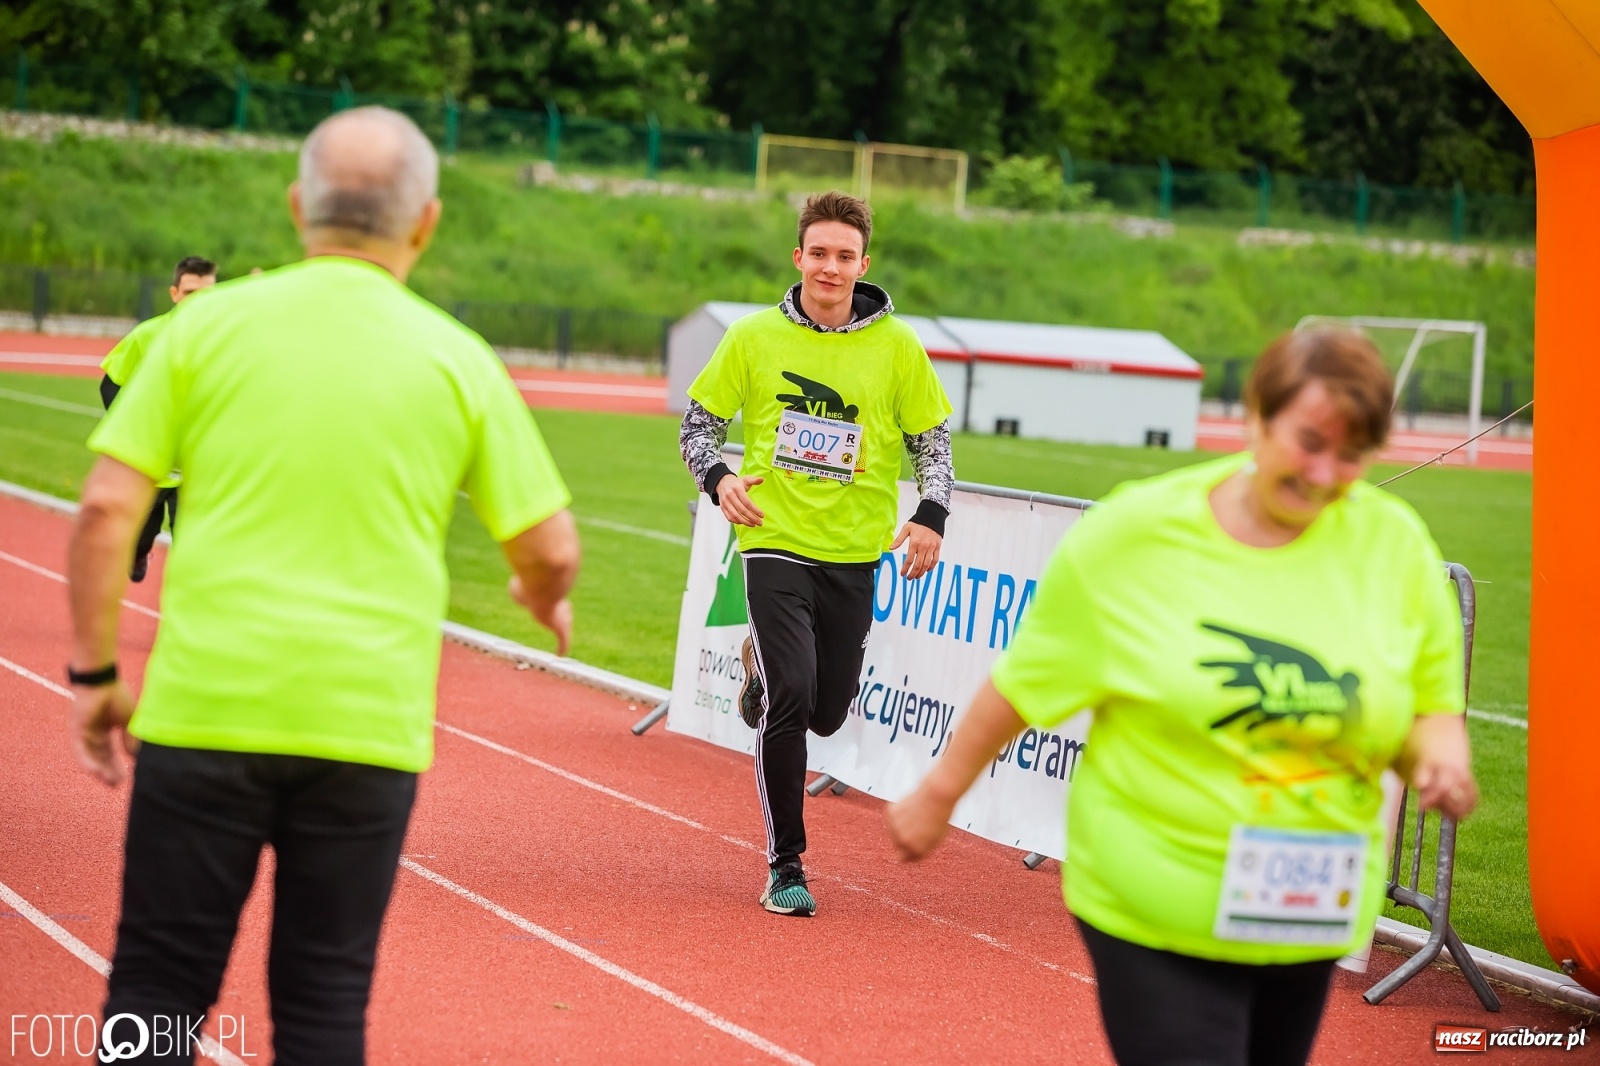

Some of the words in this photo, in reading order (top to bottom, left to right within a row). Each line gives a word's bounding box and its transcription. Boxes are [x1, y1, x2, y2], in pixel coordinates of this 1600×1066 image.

[805, 401, 827, 418] VI
[798, 429, 840, 453] 007
[873, 551, 988, 643] OWIAT
[850, 665, 955, 758] icujemy,
